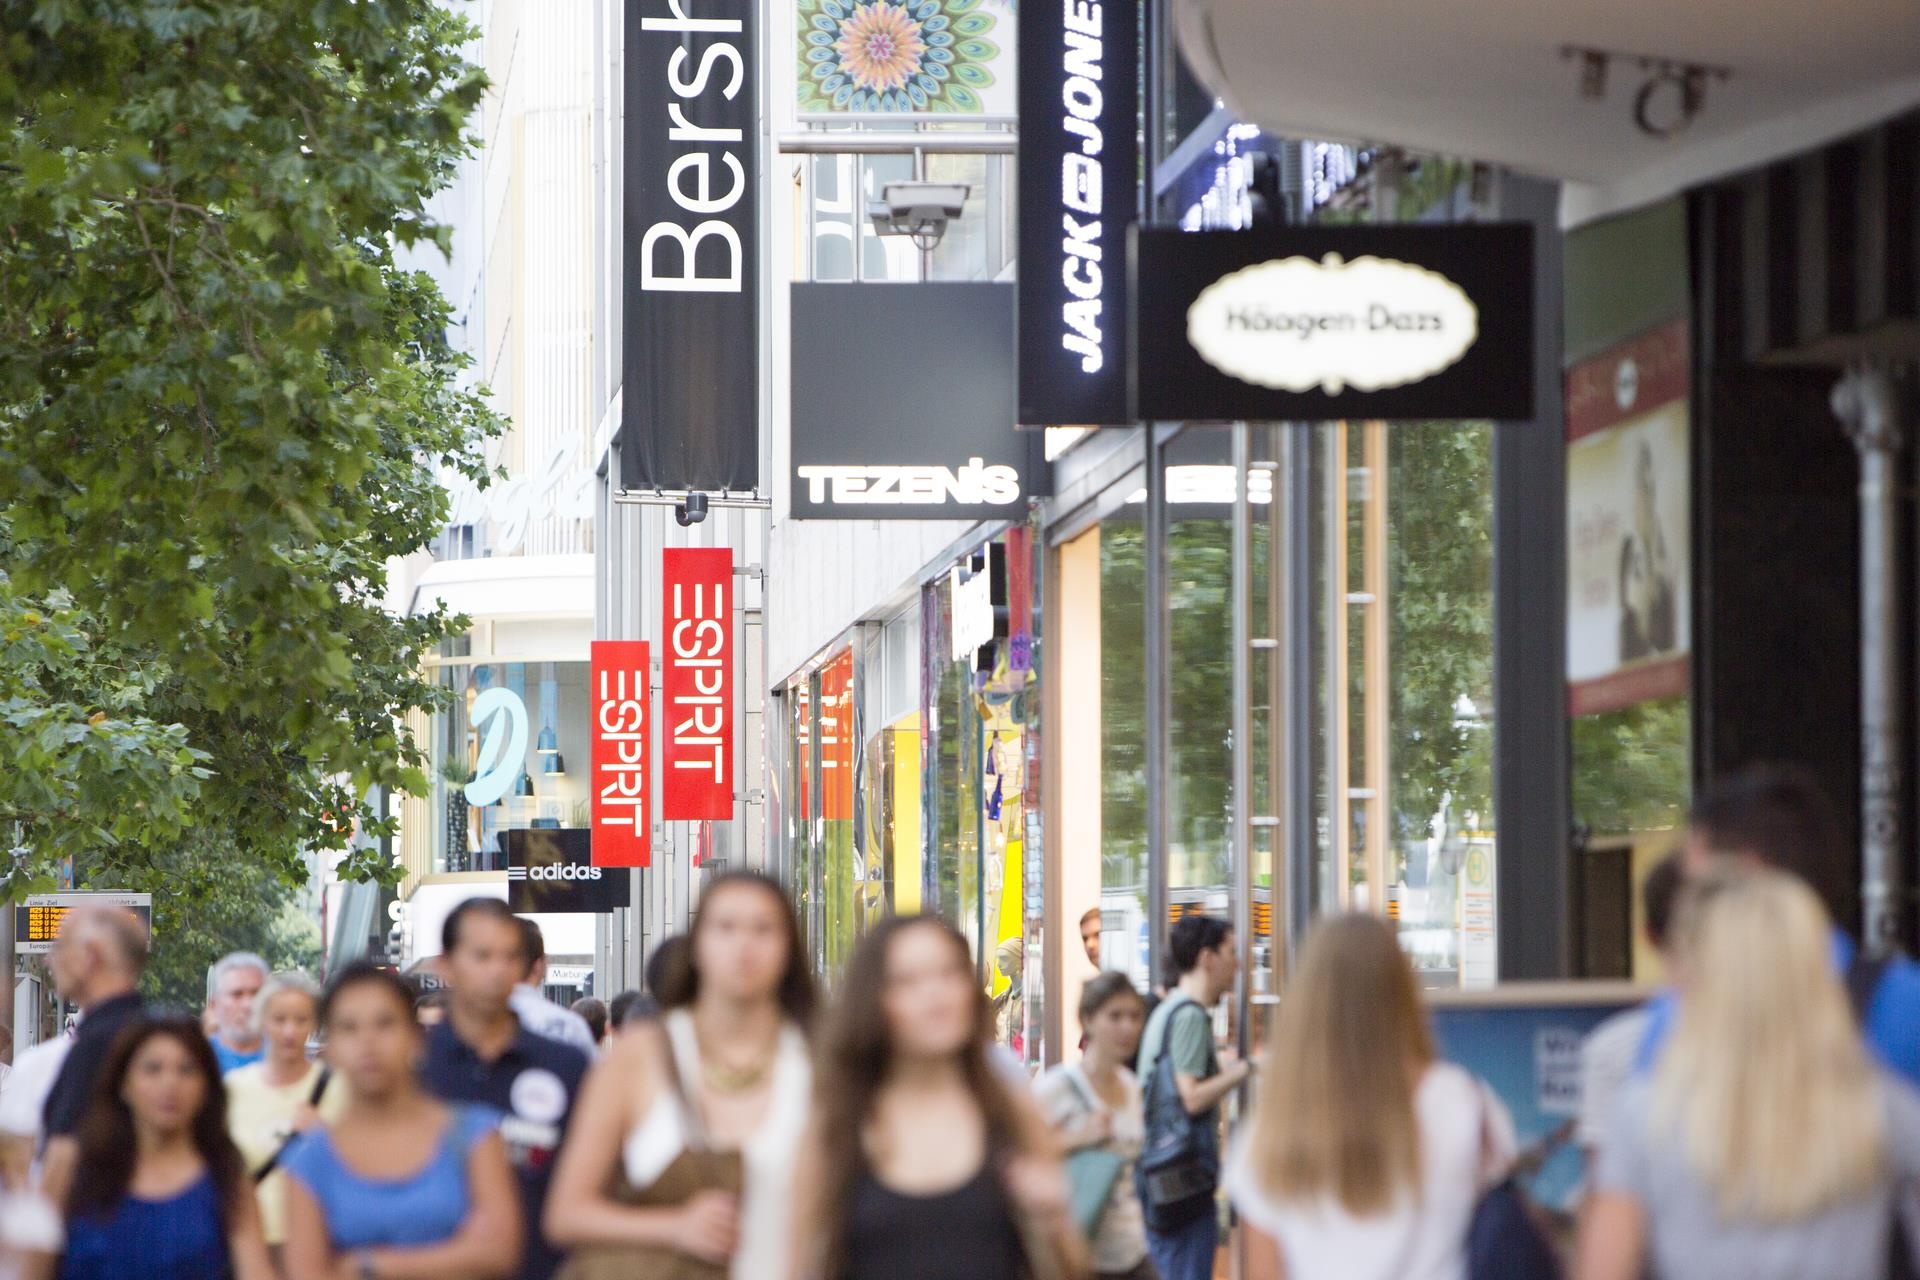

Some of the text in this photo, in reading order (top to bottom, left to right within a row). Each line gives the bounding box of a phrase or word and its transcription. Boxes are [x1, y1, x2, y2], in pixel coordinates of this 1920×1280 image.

[641, 0, 745, 293] Bersh
[1063, 0, 1103, 374] JACK JONE
[600, 670, 643, 838] ESPRIT
[673, 583, 724, 784] ESPRIT
[530, 862, 602, 880] adidas
